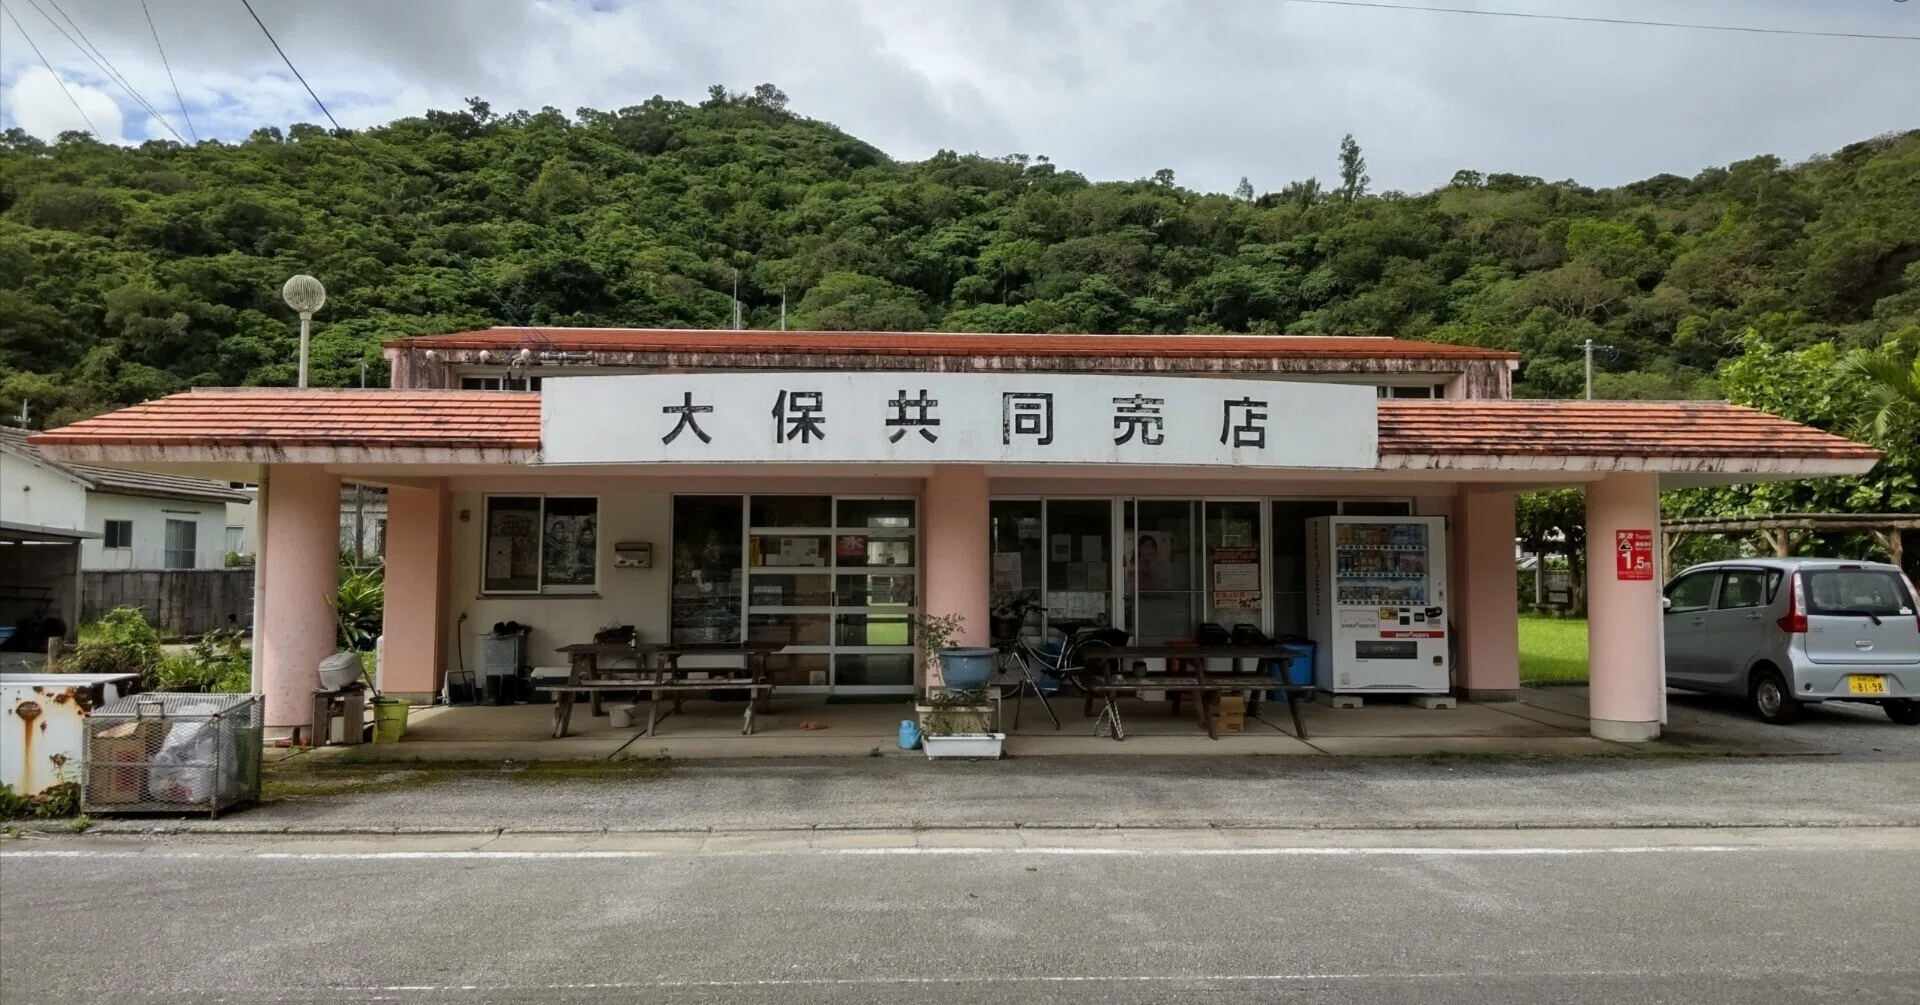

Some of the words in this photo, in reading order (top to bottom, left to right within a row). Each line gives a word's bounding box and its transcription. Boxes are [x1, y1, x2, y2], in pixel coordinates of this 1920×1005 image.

[661, 389, 1267, 449] 大保共同売店
[1622, 551, 1652, 569] 1.5m
